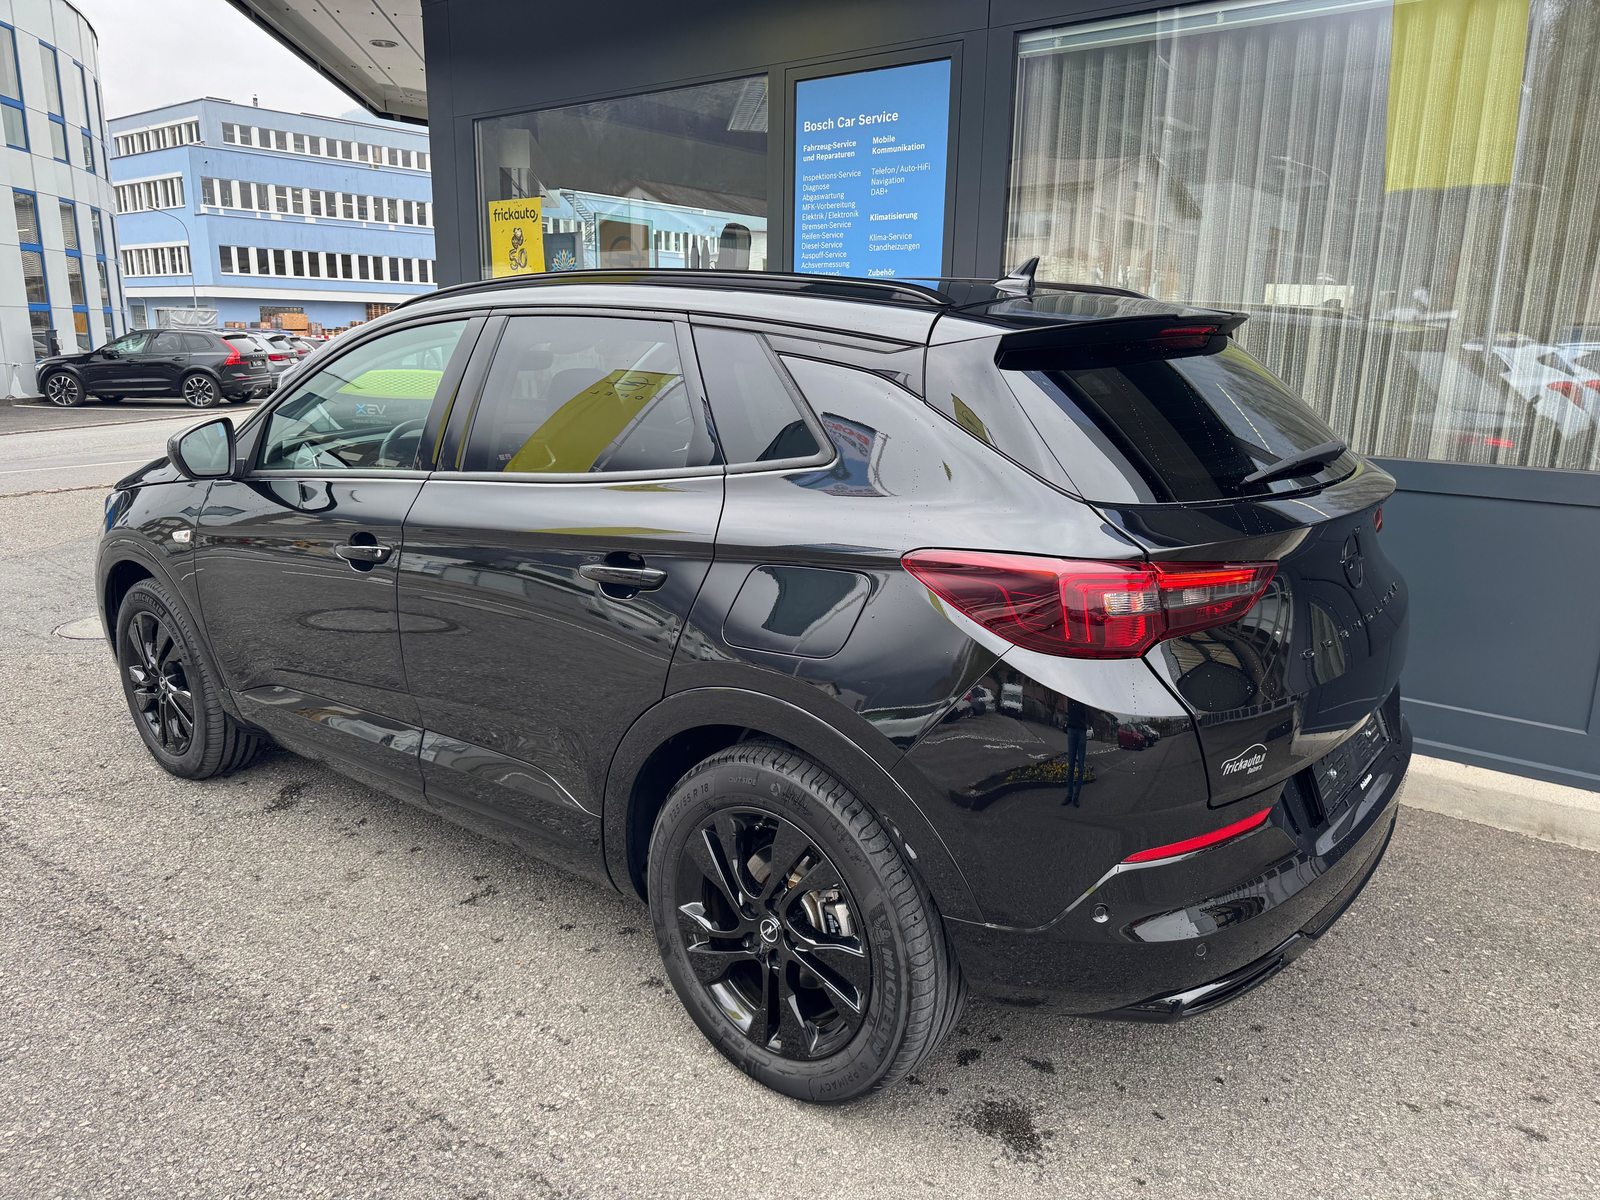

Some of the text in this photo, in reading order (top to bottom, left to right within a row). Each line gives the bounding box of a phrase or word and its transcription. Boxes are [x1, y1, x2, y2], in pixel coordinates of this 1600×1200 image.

[803, 111, 899, 132] Bosch Car Service
[872, 135, 896, 144] Mobile
[803, 140, 857, 152] Fahrzeug-Service
[871, 142, 925, 155] Kommunikation
[803, 151, 855, 162] und Reparaturen
[802, 170, 862, 182] Inspektions-Service
[871, 177, 905, 187] Navigation
[802, 183, 830, 192] Diagnose
[870, 188, 888, 196] DAB+
[802, 192, 845, 202] Abgaswartung
[802, 201, 856, 211] MFK-Vorbereitung
[870, 211, 918, 222] Klimatisierung
[802, 221, 851, 230] Bremsen-Service
[802, 231, 844, 240] Reifen-Service
[869, 233, 913, 242] Klima-Service
[801, 241, 843, 250] Diesel-Service
[868, 243, 920, 252] Standheizungen
[801, 251, 847, 260] Auspuff-Service
[801, 261, 850, 270] Achsvermessung
[868, 269, 895, 277] Zubehör
[356, 403, 386, 415] XEV
[700, 783, 709, 794] 18
